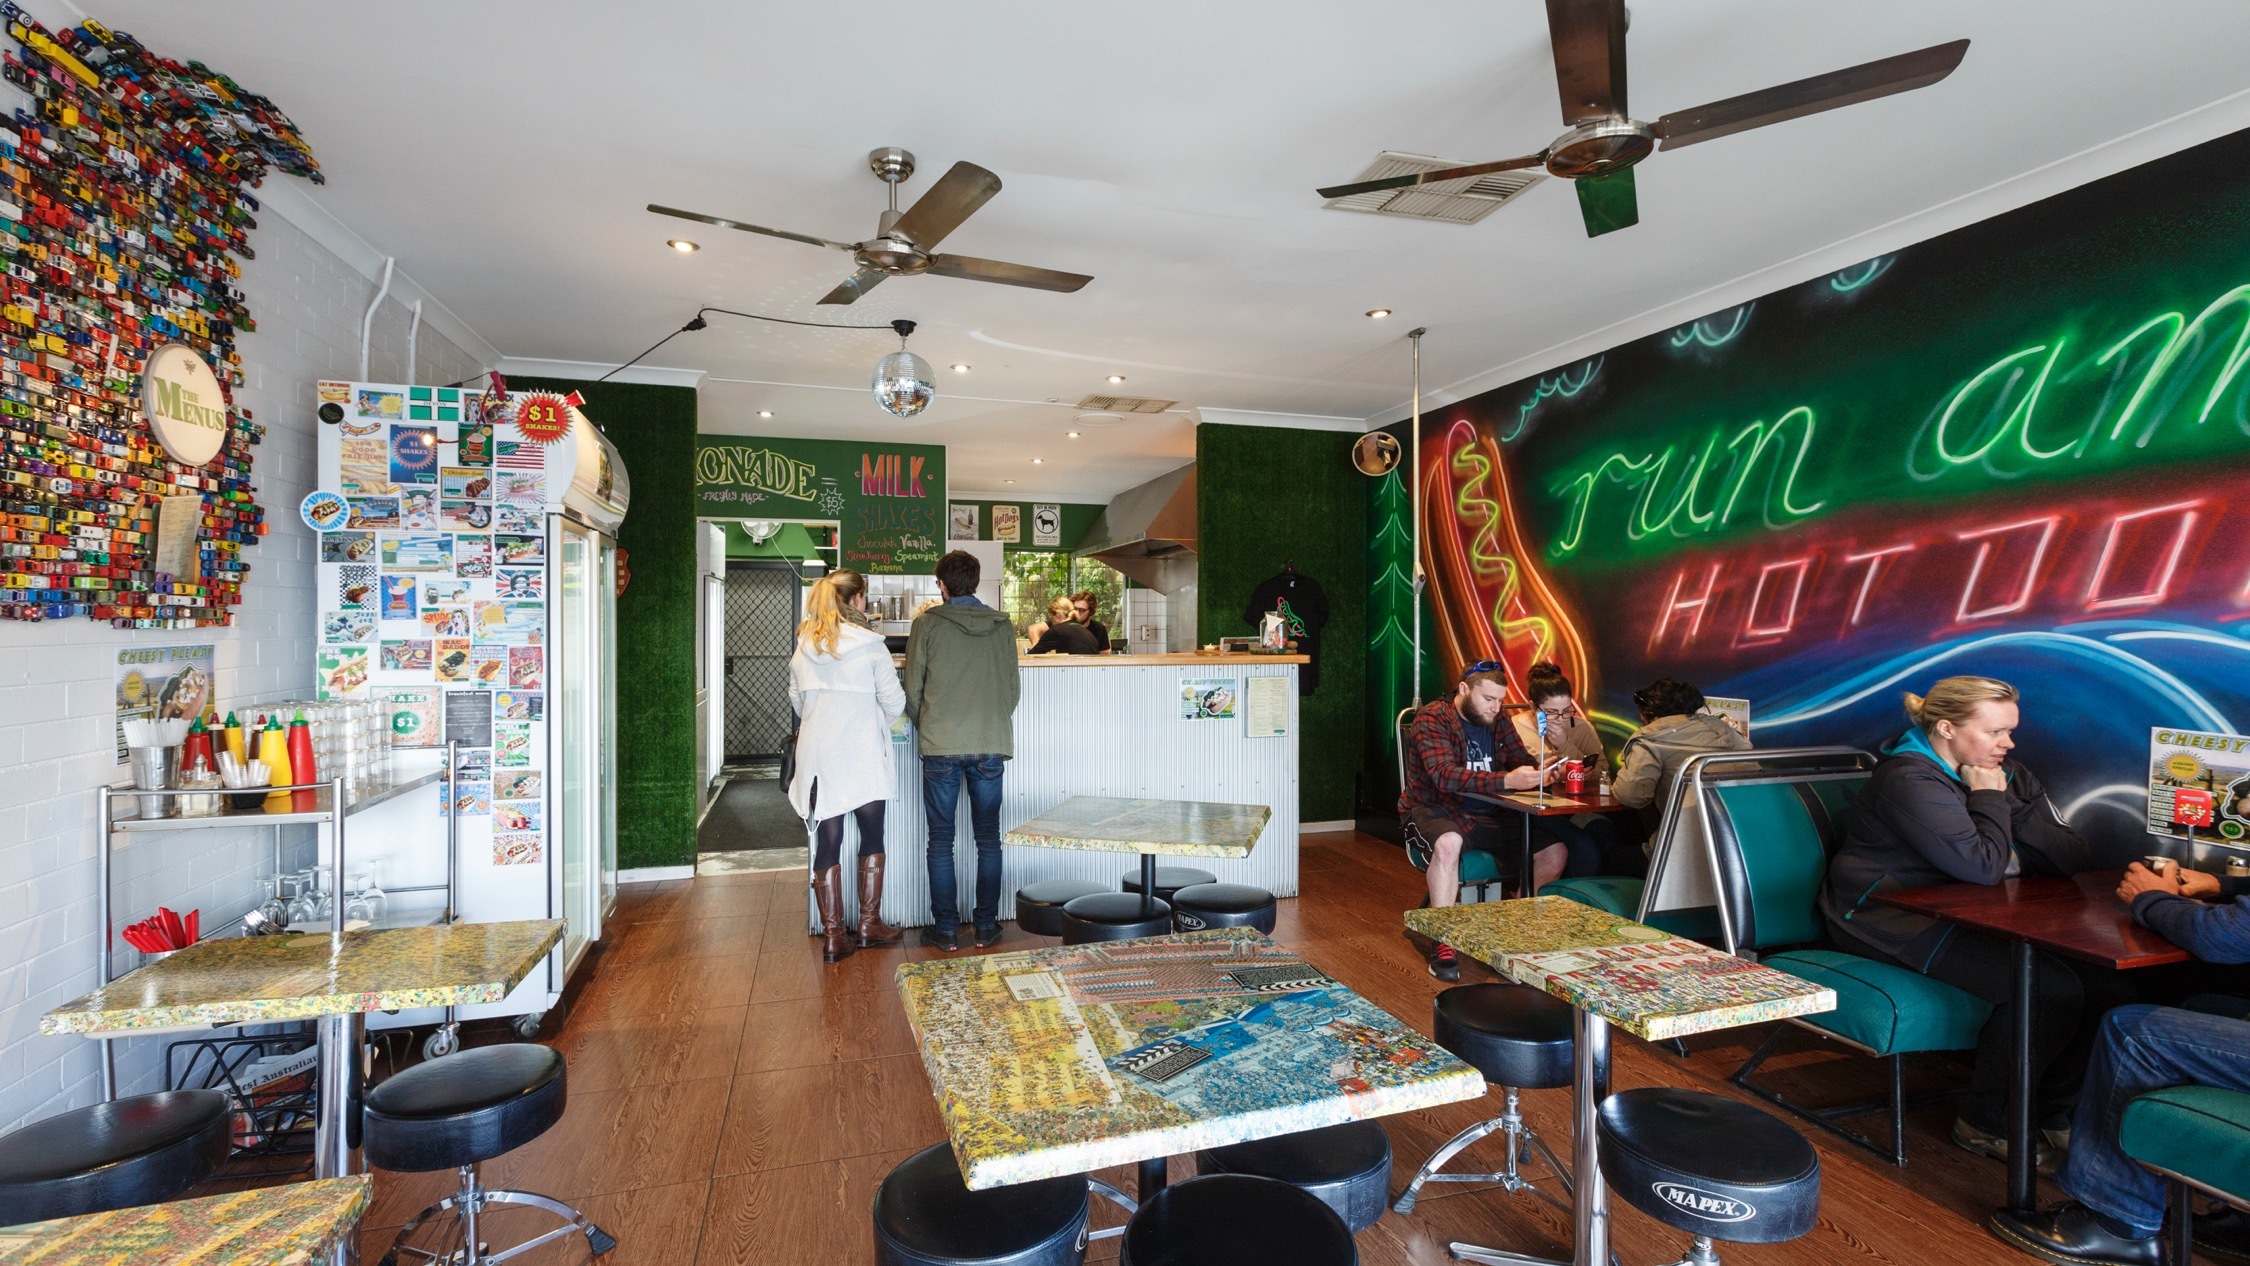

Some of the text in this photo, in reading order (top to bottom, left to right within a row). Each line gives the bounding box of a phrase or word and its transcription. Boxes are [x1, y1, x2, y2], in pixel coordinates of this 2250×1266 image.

[153, 376, 225, 432] MENUS
[181, 389, 200, 403] THE
[528, 404, 557, 423] $1
[525, 423, 561, 432] SHAKES!
[696, 445, 818, 502] ONADE
[861, 453, 927, 498] MILK
[1558, 405, 1828, 552] run
[825, 495, 839, 509] $5
[856, 501, 936, 537] SHAKES
[1656, 499, 2250, 646] HOT DO
[118, 646, 214, 665] CHEESY PLEASY
[1706, 699, 1747, 711] PLEASY
[396, 717, 415, 727] $1
[2155, 730, 2249, 753] CHEESY
[1177, 913, 1199, 927] MAPEX
[1667, 1187, 1739, 1216] MAPEX
